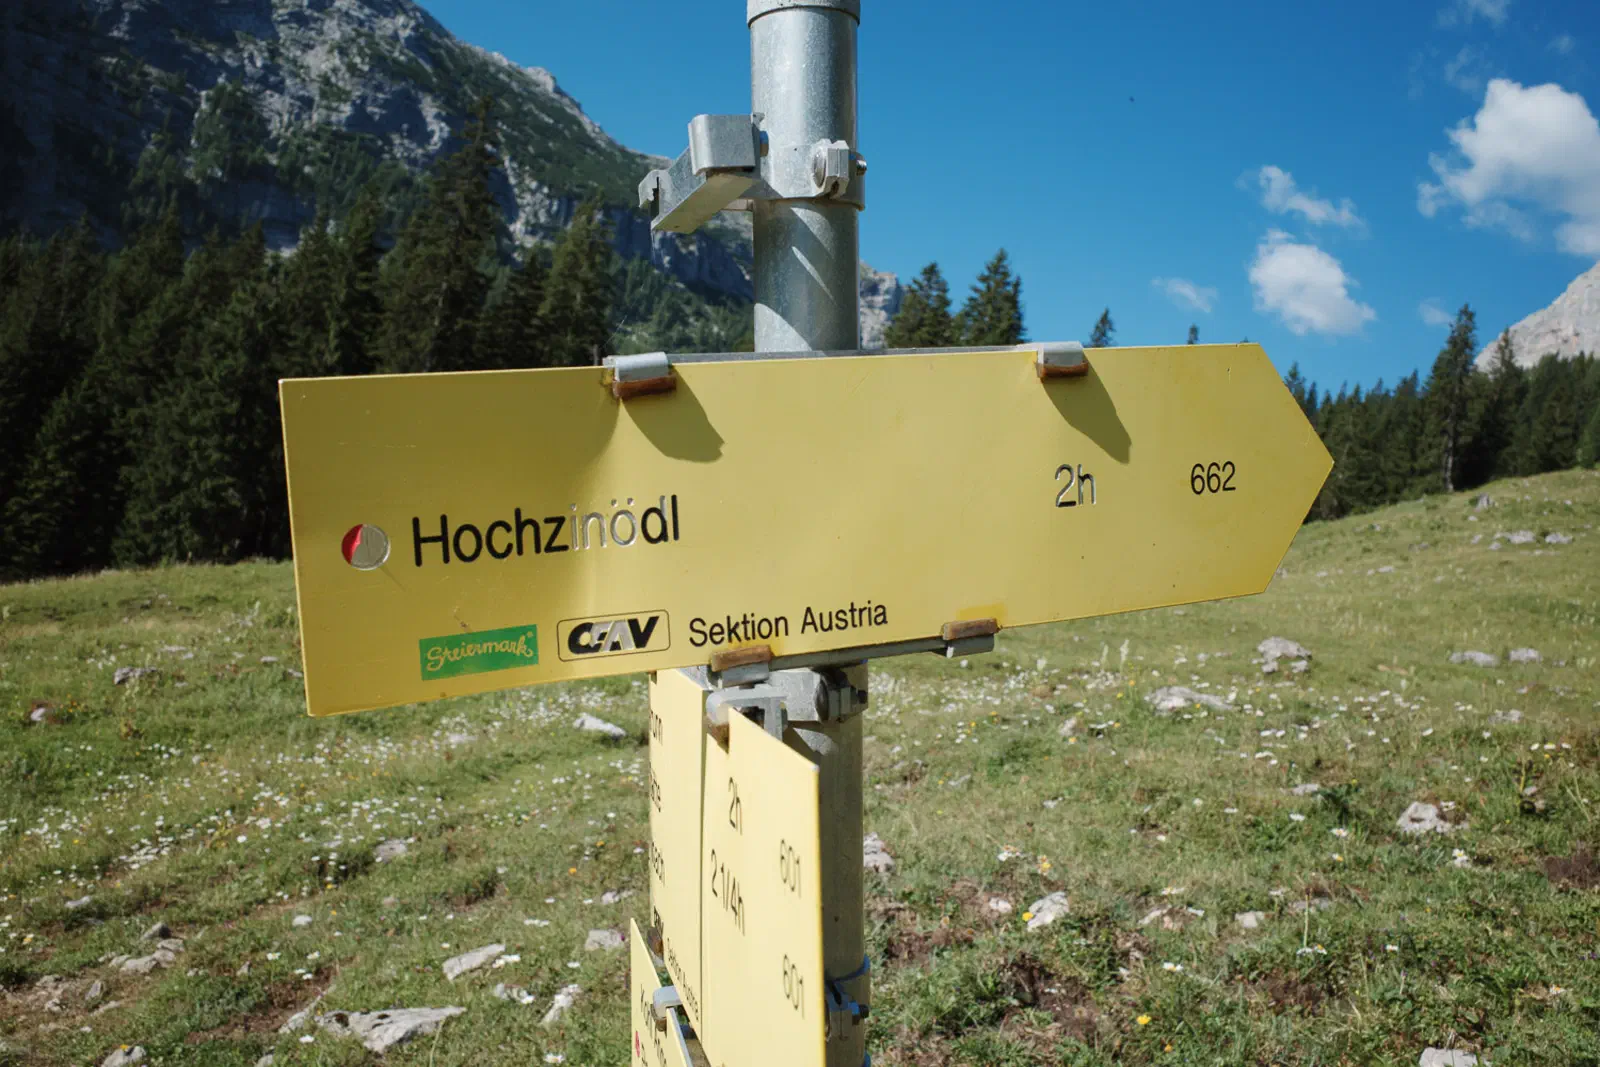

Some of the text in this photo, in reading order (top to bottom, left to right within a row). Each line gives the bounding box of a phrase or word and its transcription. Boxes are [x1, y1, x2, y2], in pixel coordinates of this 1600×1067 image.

[1054, 463, 1096, 507] 2h
[1190, 461, 1236, 495] 662
[411, 494, 680, 567] Hochzinödl
[689, 600, 889, 647] Sektion Austria
[426, 633, 534, 671] Steiermark
[728, 776, 743, 836] 2h
